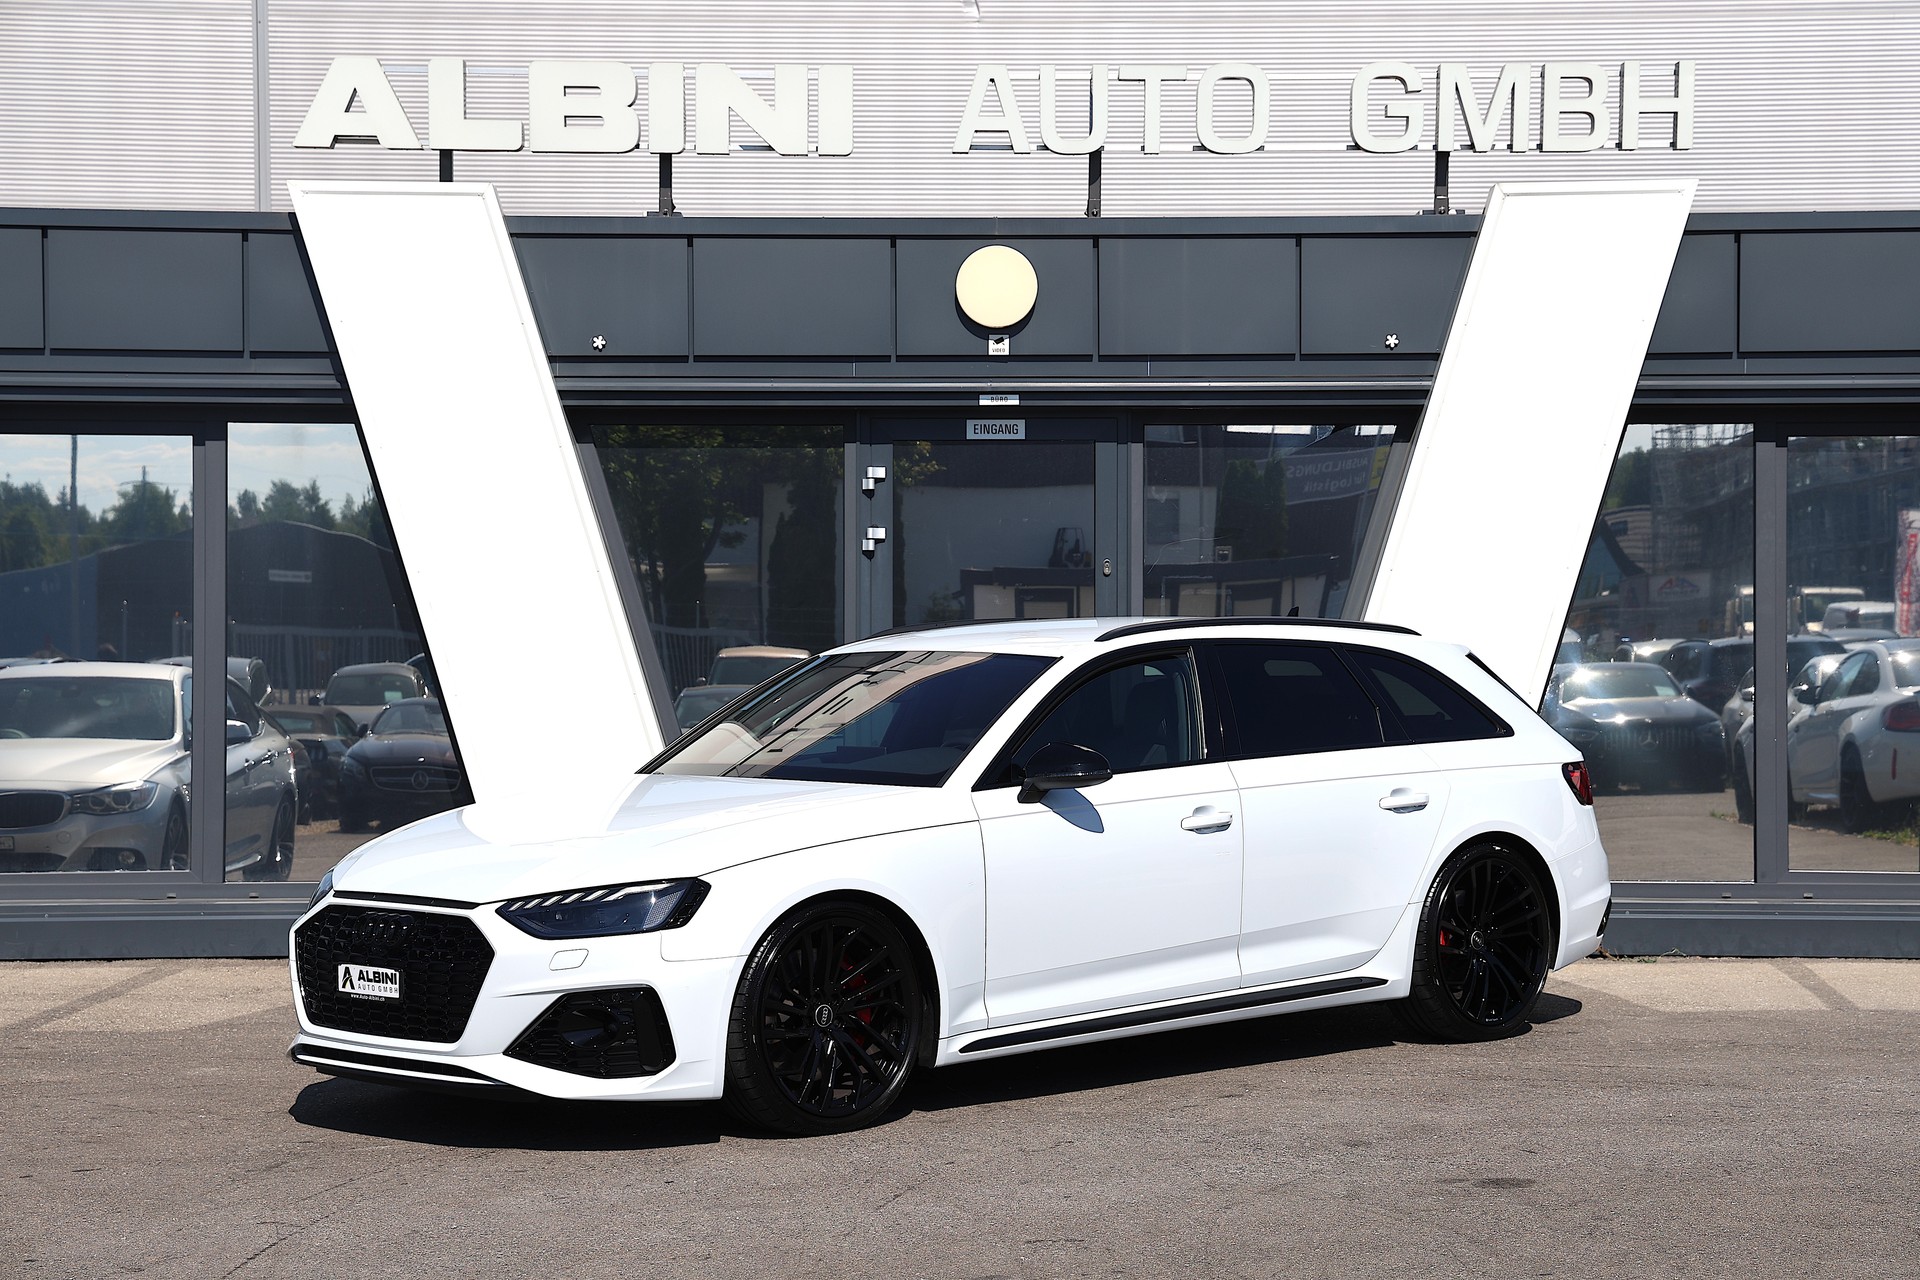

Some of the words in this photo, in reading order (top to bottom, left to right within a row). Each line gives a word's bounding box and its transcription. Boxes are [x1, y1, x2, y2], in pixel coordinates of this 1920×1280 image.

[292, 56, 854, 157] ALBINI
[952, 62, 1271, 156] AUTO
[1350, 59, 1697, 155] GMBH
[990, 395, 1009, 403] BÜRO
[973, 423, 1019, 435] EINGANG
[357, 969, 398, 986] ALBINI
[358, 983, 376, 992] AUTO
[377, 985, 399, 994] GMBH
